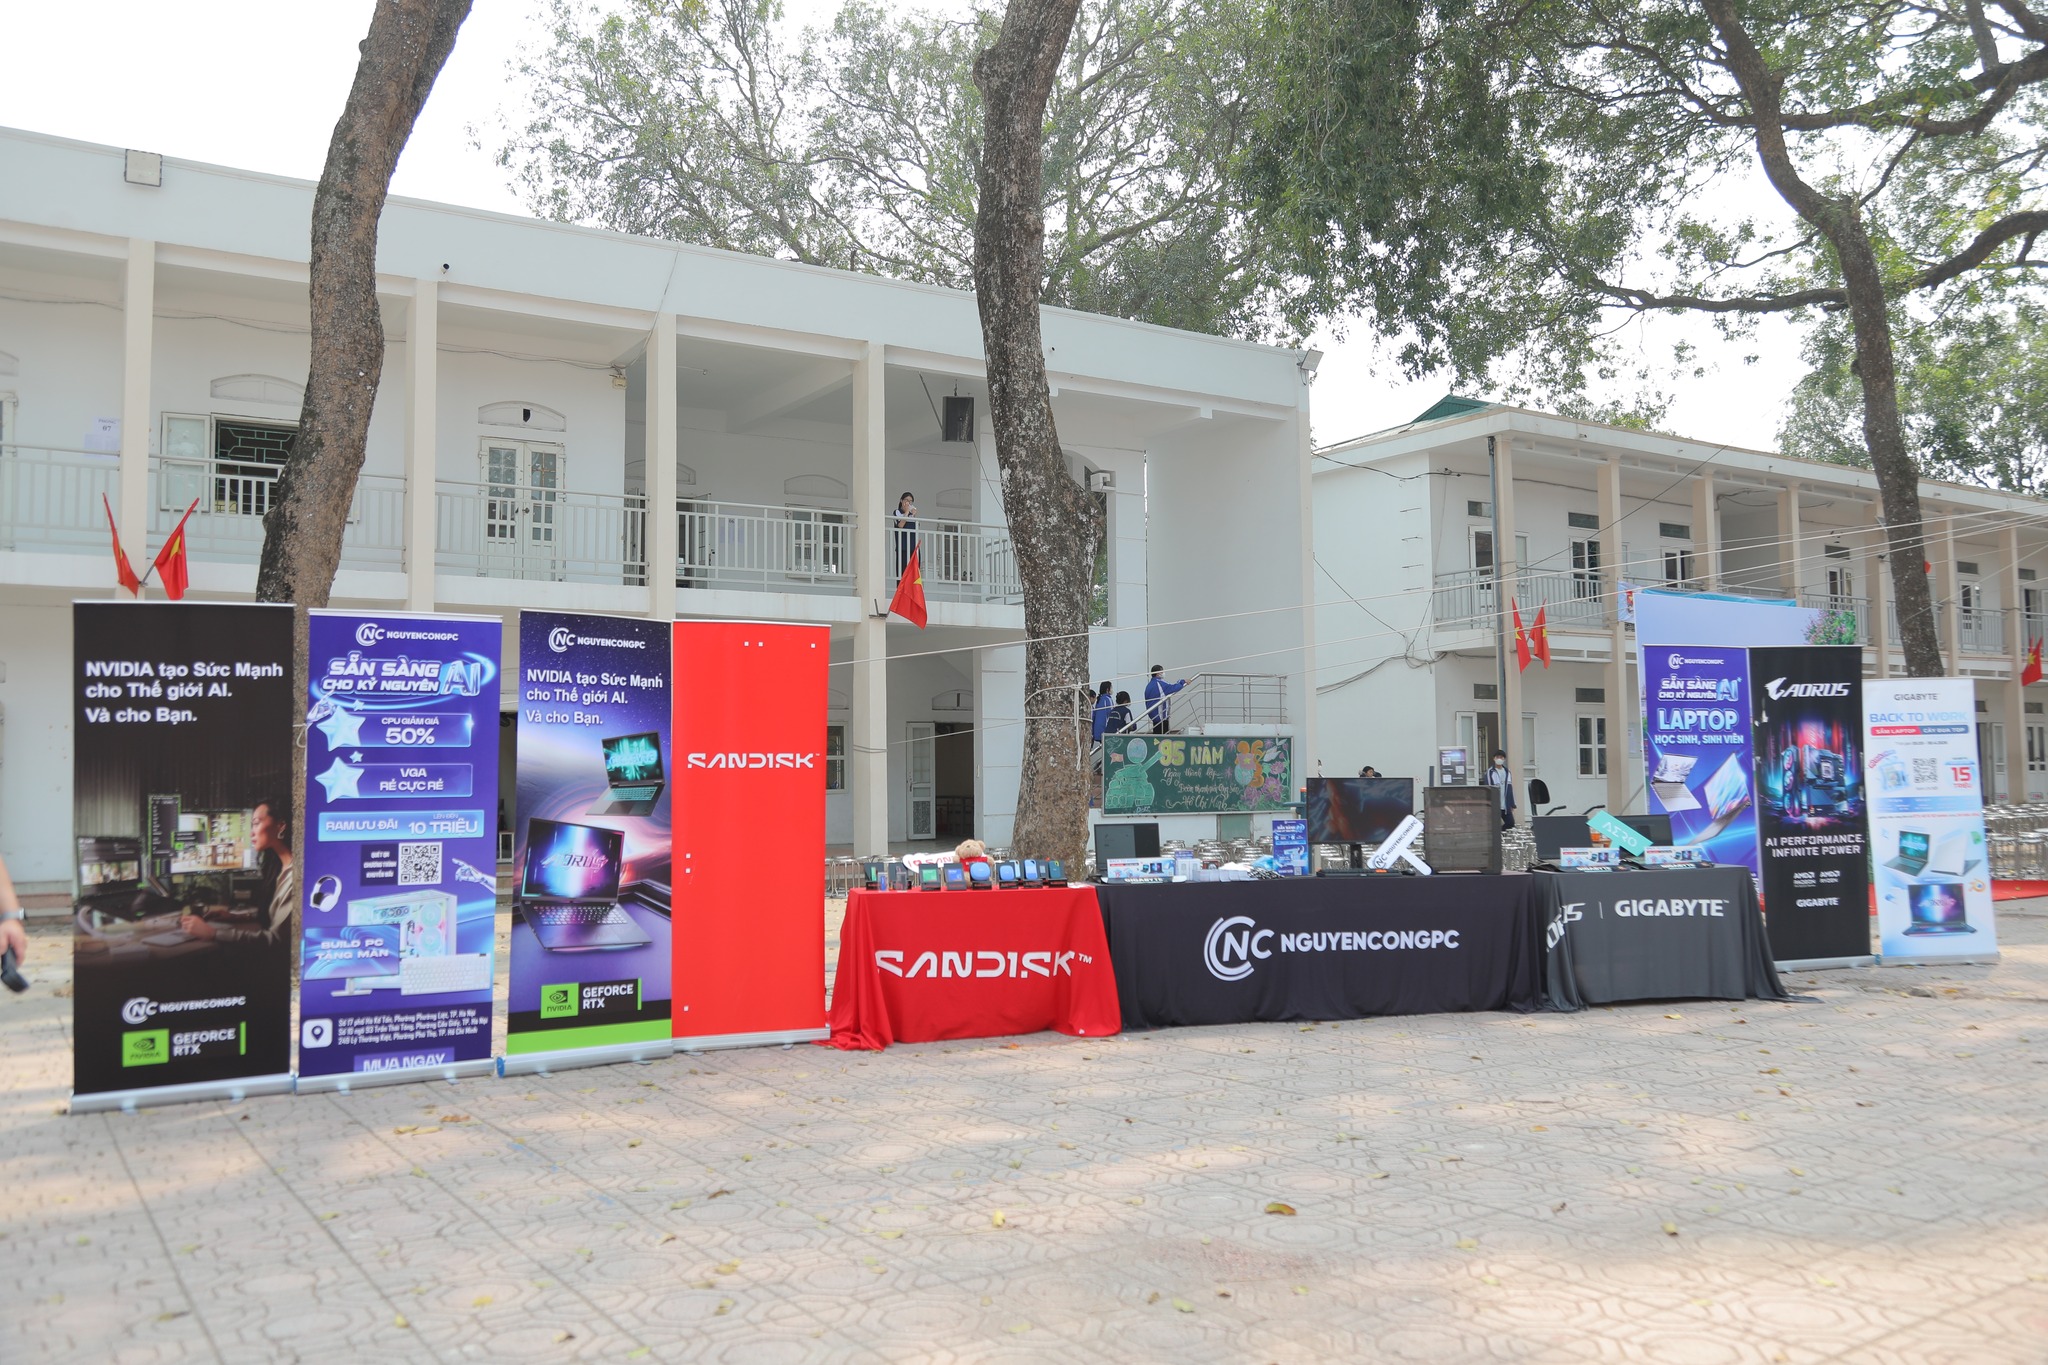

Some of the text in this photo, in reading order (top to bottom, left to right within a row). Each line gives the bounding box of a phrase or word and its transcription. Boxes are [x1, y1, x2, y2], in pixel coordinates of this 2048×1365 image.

[386, 631, 459, 641] NGUYENCONGPC
[577, 636, 646, 650] NGUYENCONGPC
[86, 661, 283, 680] NVIDIA tạo Sức Mạnh
[329, 653, 481, 696] SẴN SÀNG AI
[322, 676, 439, 692] CHO KỶ NGUYÊN
[527, 668, 663, 690] NVIDIA tạo Sức Mạnh
[86, 679, 233, 701] cho Thế giới AI.
[526, 686, 629, 706] cho Thế giới AI.
[1658, 691, 1675, 699] CHO
[1686, 690, 1717, 699] NGUYÊN
[1661, 674, 1739, 702] SẴN SÀNG AI
[1782, 682, 1853, 698] AORUS
[1893, 692, 1939, 701] GIGABYTE
[85, 707, 198, 725] Và cho Bạn.
[381, 716, 440, 726] CPU GIẢM GIÁ
[525, 709, 603, 728] Và cho Bạn.
[1658, 709, 1738, 731] LAPTOP
[1869, 711, 1968, 723] BACK TO WORK
[385, 727, 435, 745] 50%
[1891, 727, 1916, 735] LAPTOP
[1654, 732, 1744, 747] HỌC SINH, SINH VIÊN
[1159, 739, 1224, 767] 95 NĂM
[400, 768, 427, 778] VGA
[1161, 767, 1181, 786] Ngày
[1950, 766, 1973, 782] 15
[379, 779, 444, 793] RẺ CỰC RẺ
[325, 818, 398, 831] RAM ƯU ĐÃI
[408, 817, 478, 836] 10 TRIỆU
[1765, 837, 1778, 847] AI
[1772, 844, 1861, 858] INFINITE POWER
[1614, 899, 1724, 918] GIGABYTE
[1796, 897, 1840, 907] GIGABYTE
[320, 938, 384, 949] BUILD PC
[1280, 929, 1460, 953] NGUYENCONGPC
[315, 948, 389, 962] TẶNG MÀN
[583, 984, 634, 999] GEFORCE
[160, 996, 246, 1013] NGUYENCONGPC
[546, 1004, 573, 1013] NVIDIA
[583, 998, 606, 1010] RTX
[173, 1028, 236, 1046] GEFORCE
[173, 1043, 201, 1057] RTX
[363, 1053, 446, 1073] MUA NGAY
